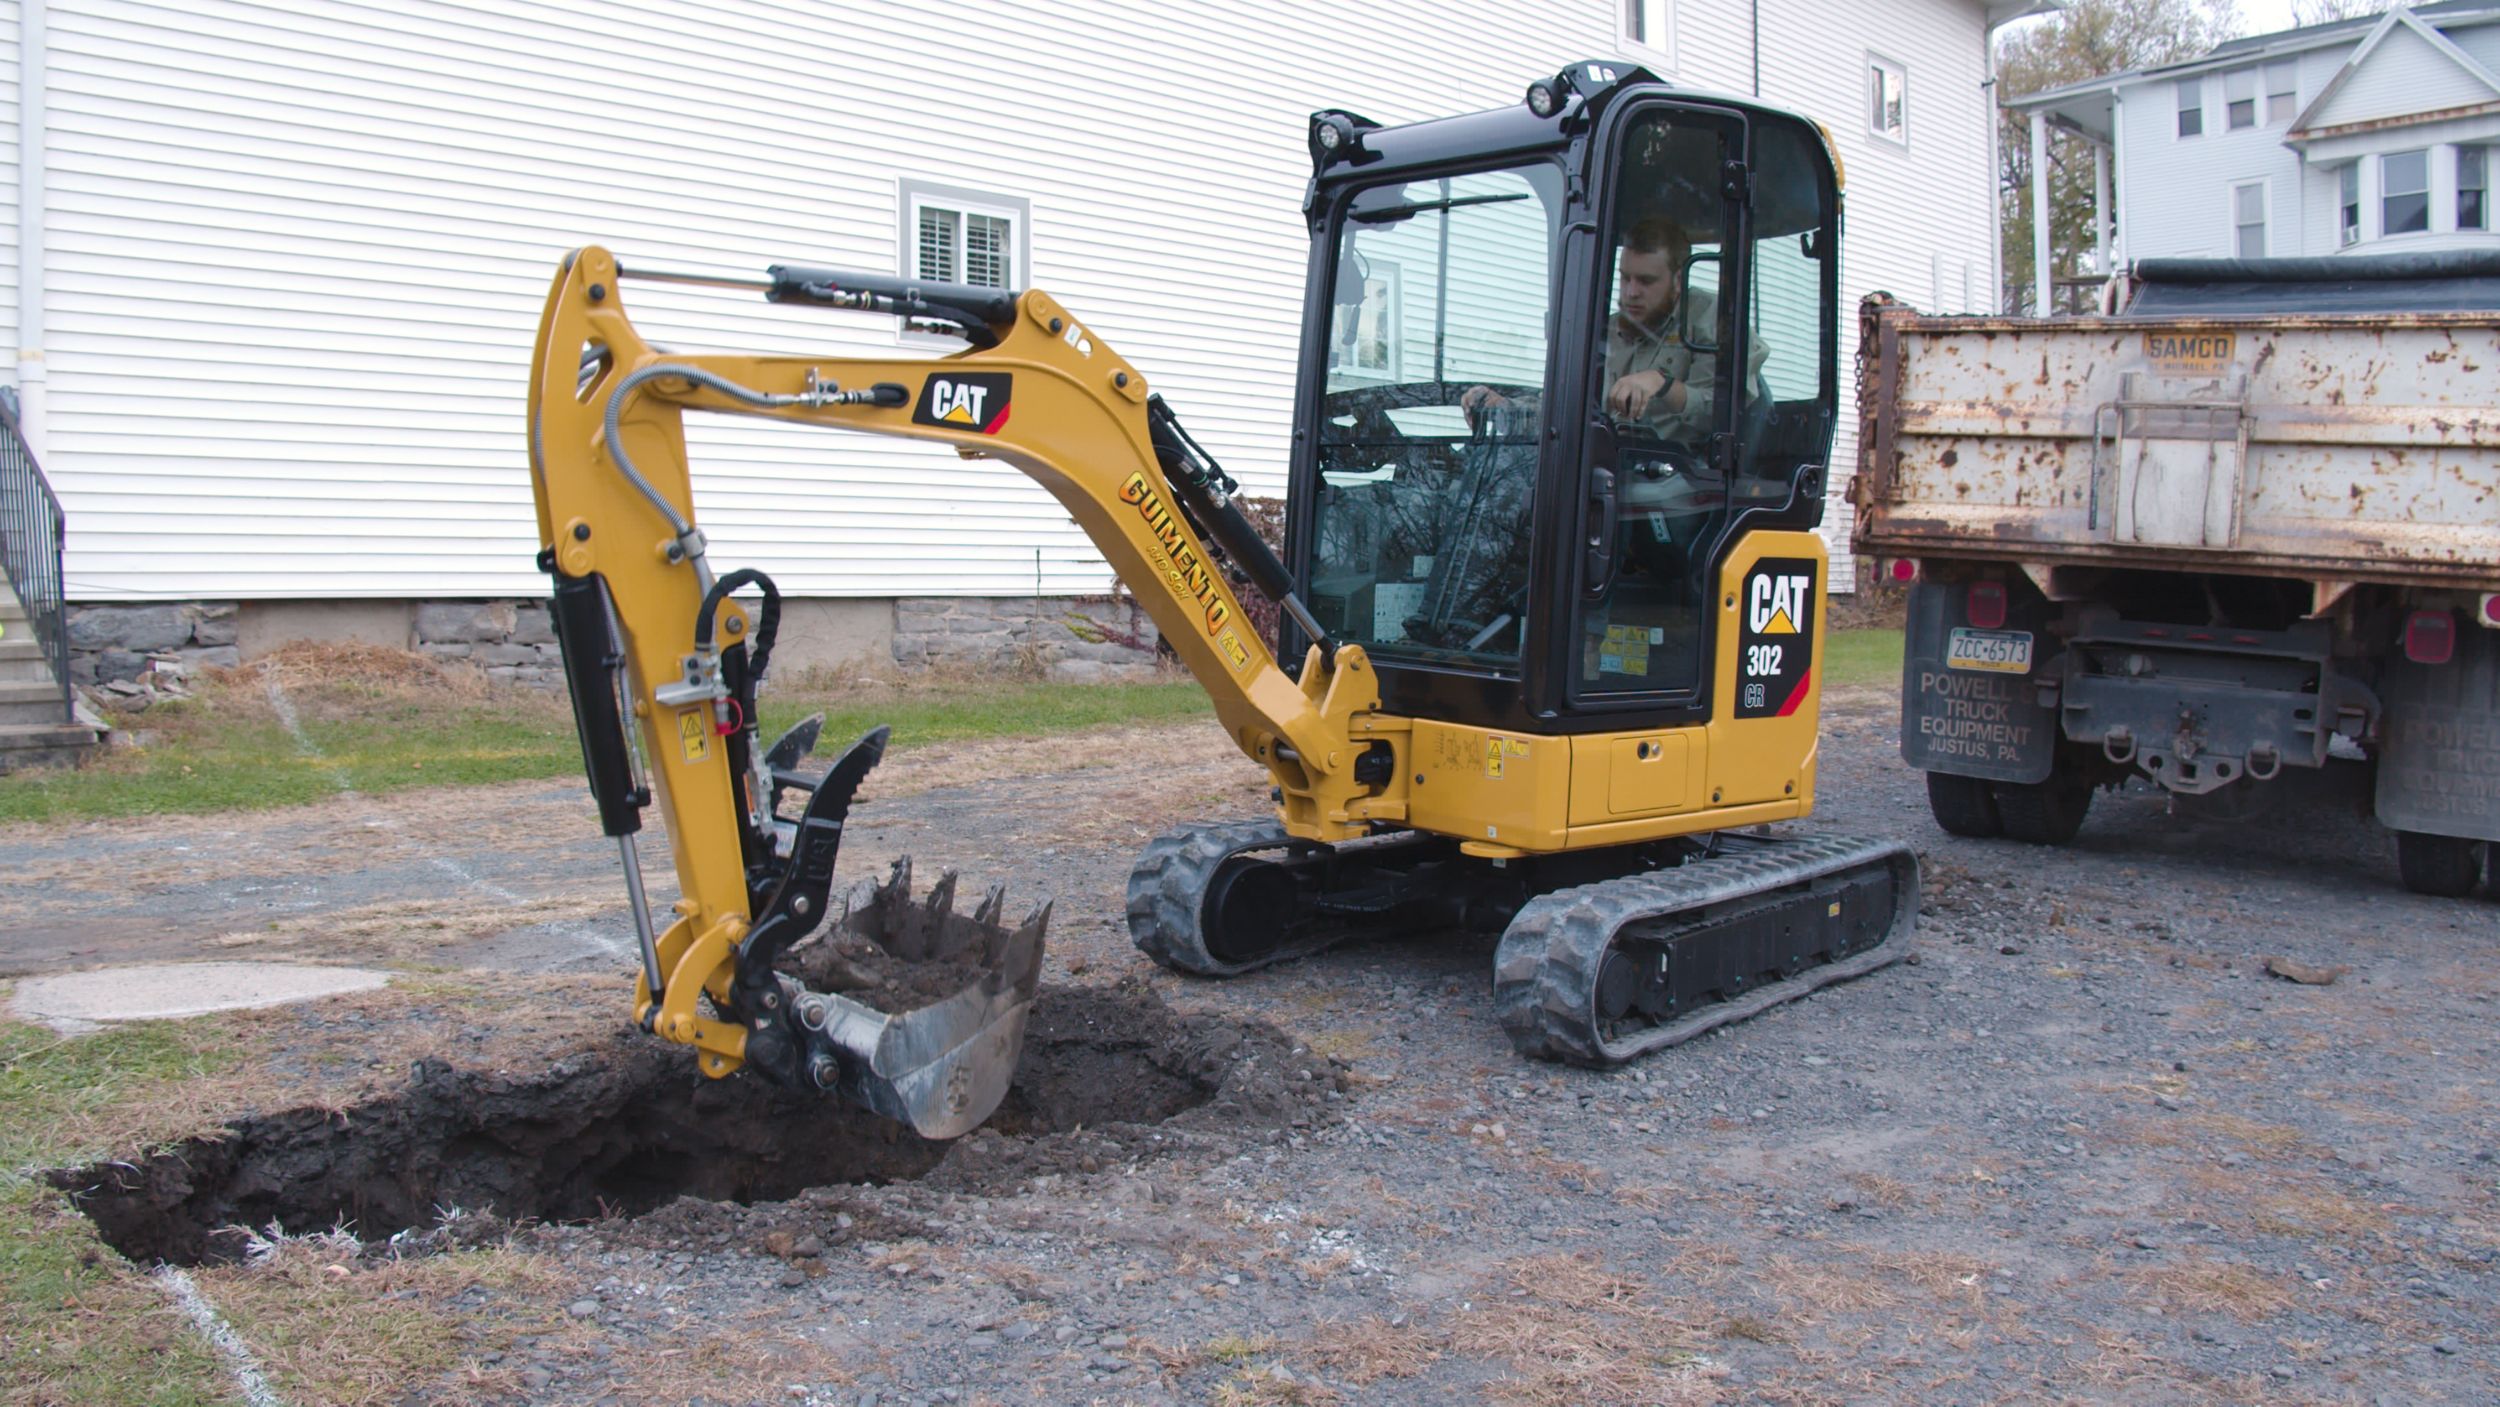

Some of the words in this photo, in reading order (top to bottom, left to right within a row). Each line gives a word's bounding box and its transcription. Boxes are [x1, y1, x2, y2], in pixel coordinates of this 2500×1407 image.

[2150, 337, 2228, 358] SAMCO
[932, 379, 987, 425] CAT
[1119, 470, 1230, 637] GUIMENTO
[1750, 573, 1809, 634] CAT
[1746, 645, 1783, 676] 302
[1744, 683, 1765, 708] CR
[1944, 698, 2009, 722] TRUCK
[1920, 716, 2031, 745] EQUIPMENT
[1928, 737, 1990, 760] JUSTUS,
